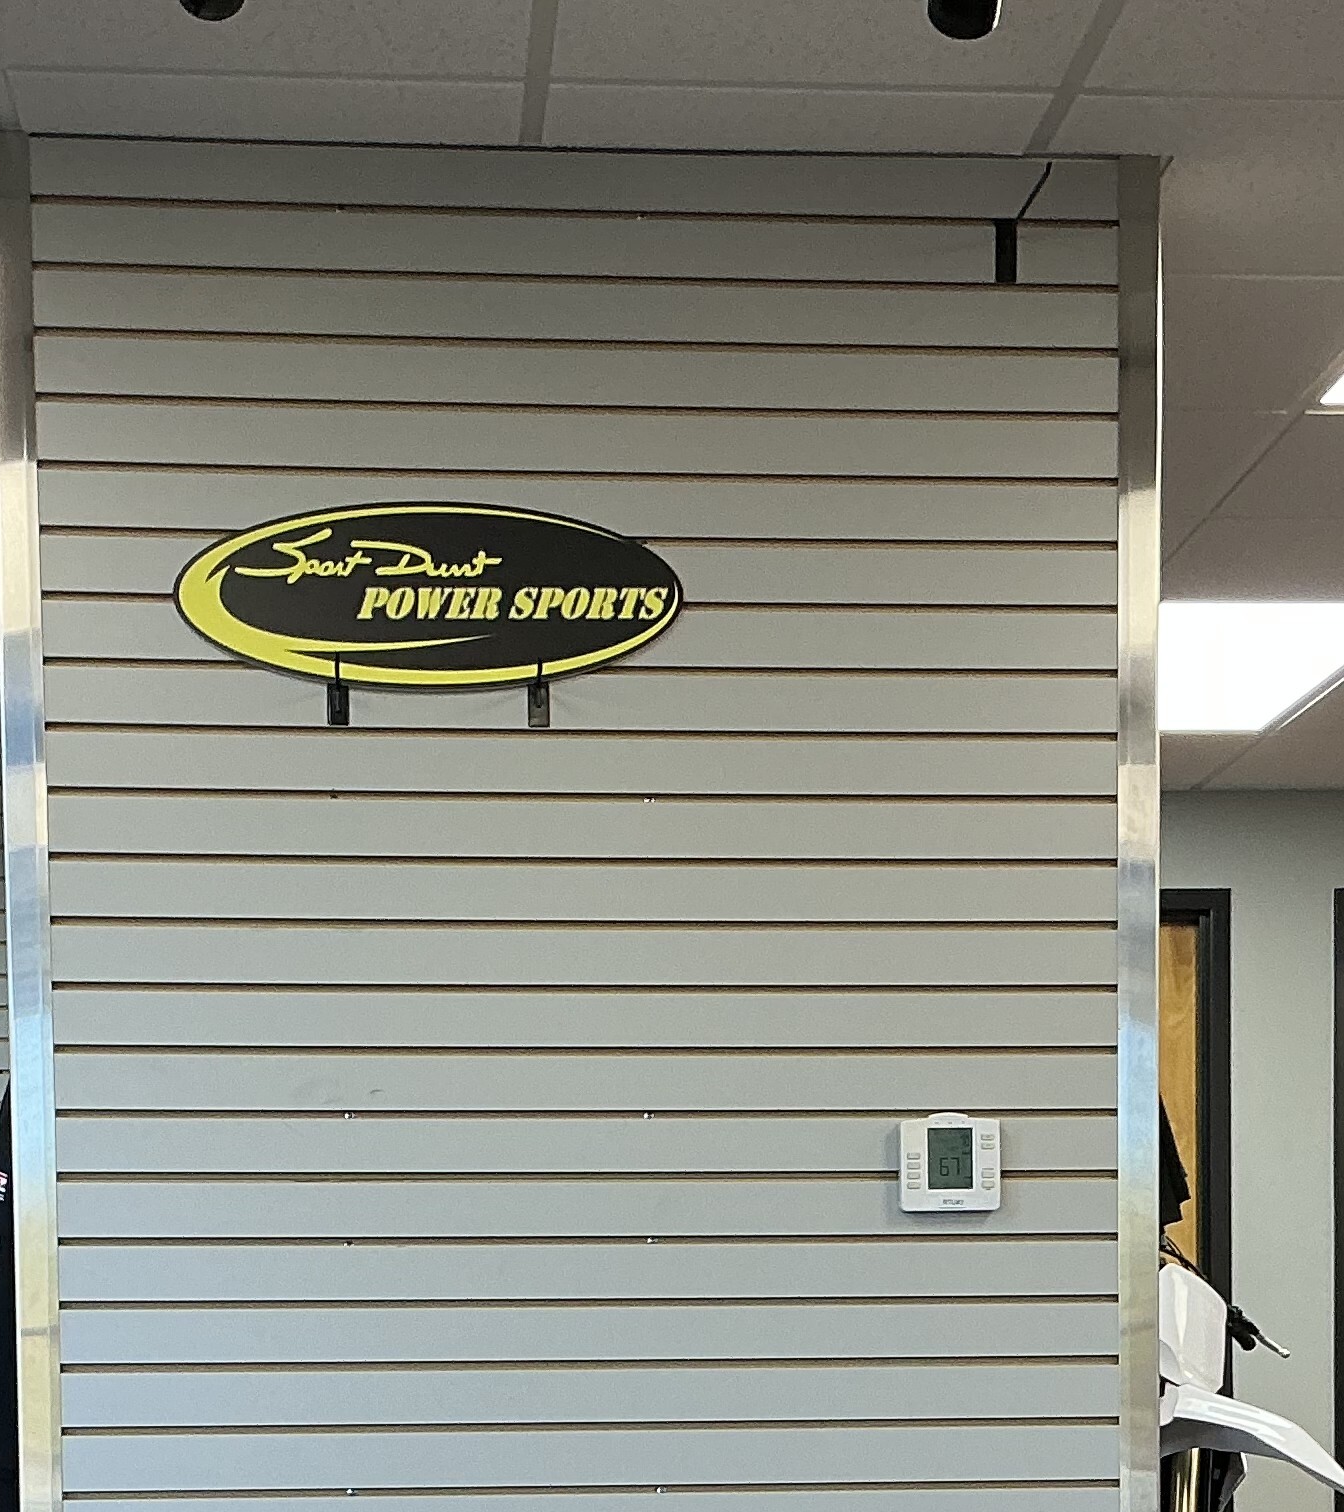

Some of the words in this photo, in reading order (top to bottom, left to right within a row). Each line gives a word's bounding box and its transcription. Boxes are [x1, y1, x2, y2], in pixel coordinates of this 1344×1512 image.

[356, 586, 503, 621] POWER
[508, 586, 669, 621] SPORTS
[939, 1157, 960, 1177] 67
